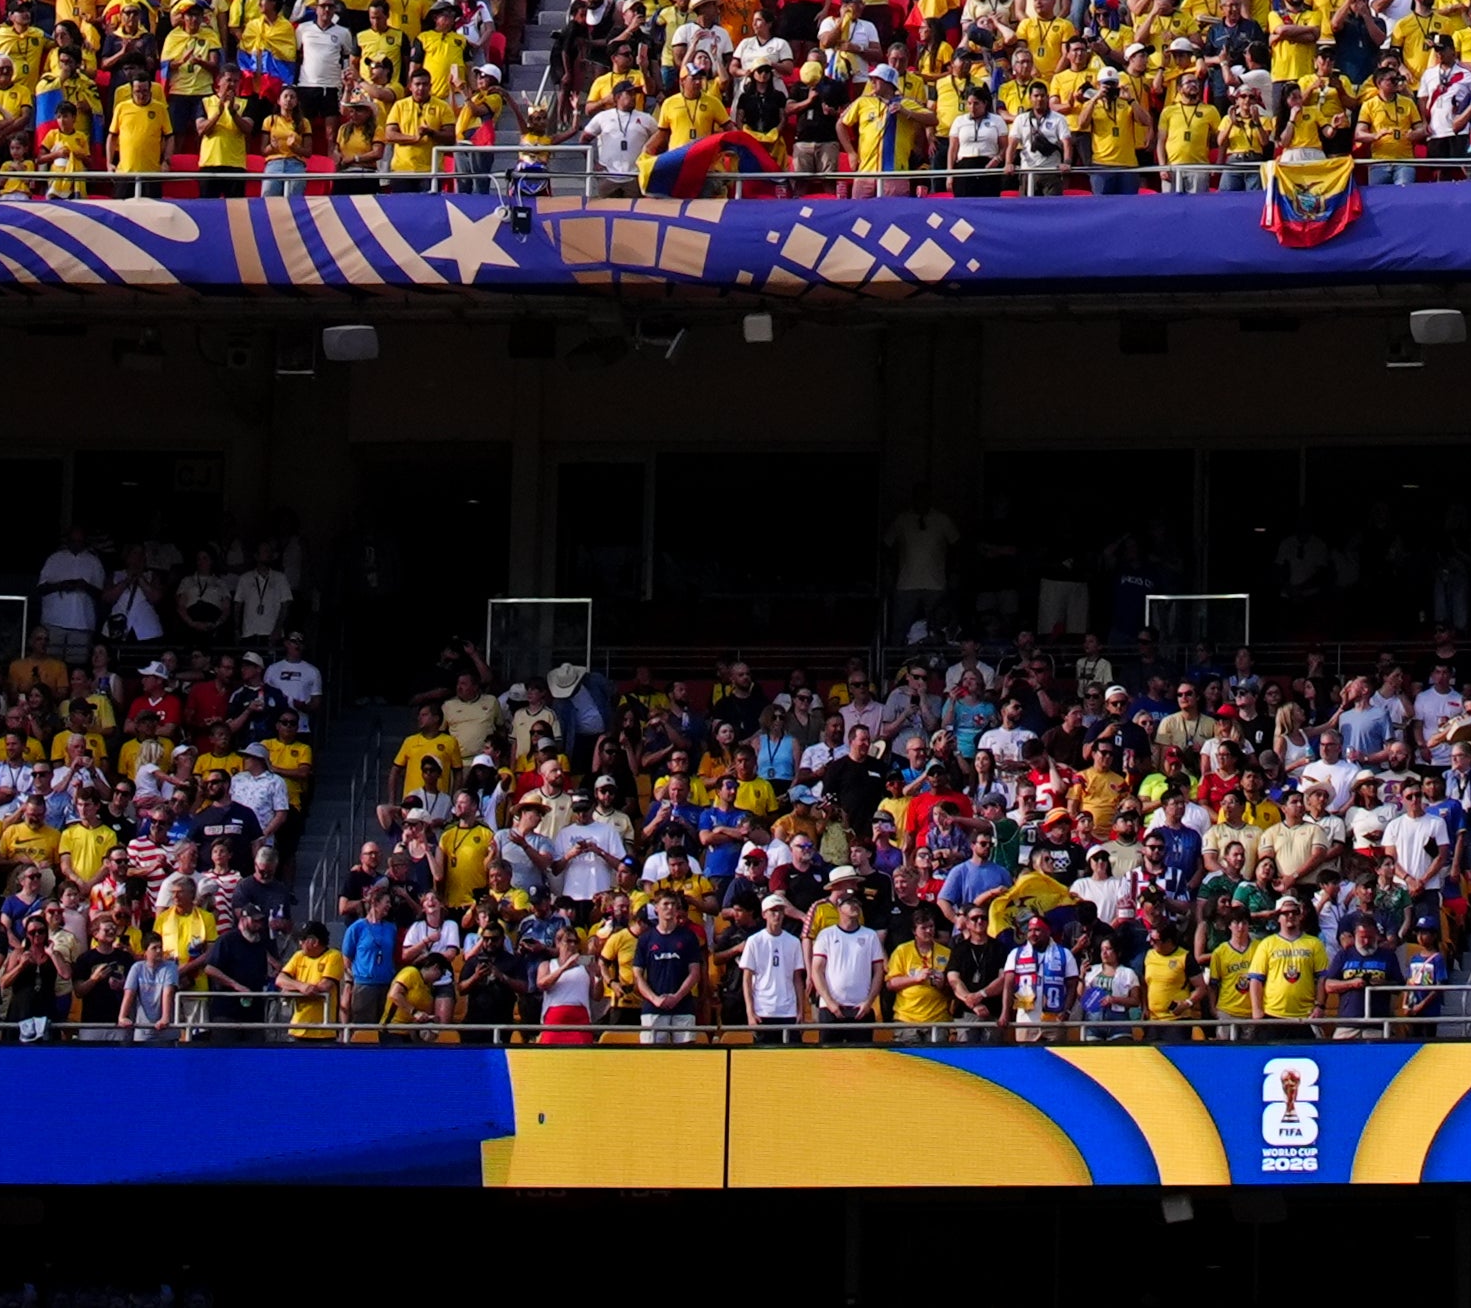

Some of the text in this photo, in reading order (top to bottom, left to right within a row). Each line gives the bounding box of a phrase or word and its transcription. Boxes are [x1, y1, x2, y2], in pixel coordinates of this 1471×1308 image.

[1271, 948, 1312, 959] ECUADOR
[1278, 1128, 1303, 1137] FIFA
[1262, 1148, 1318, 1157] WORLD CUP
[1262, 1157, 1318, 1171] 2026
